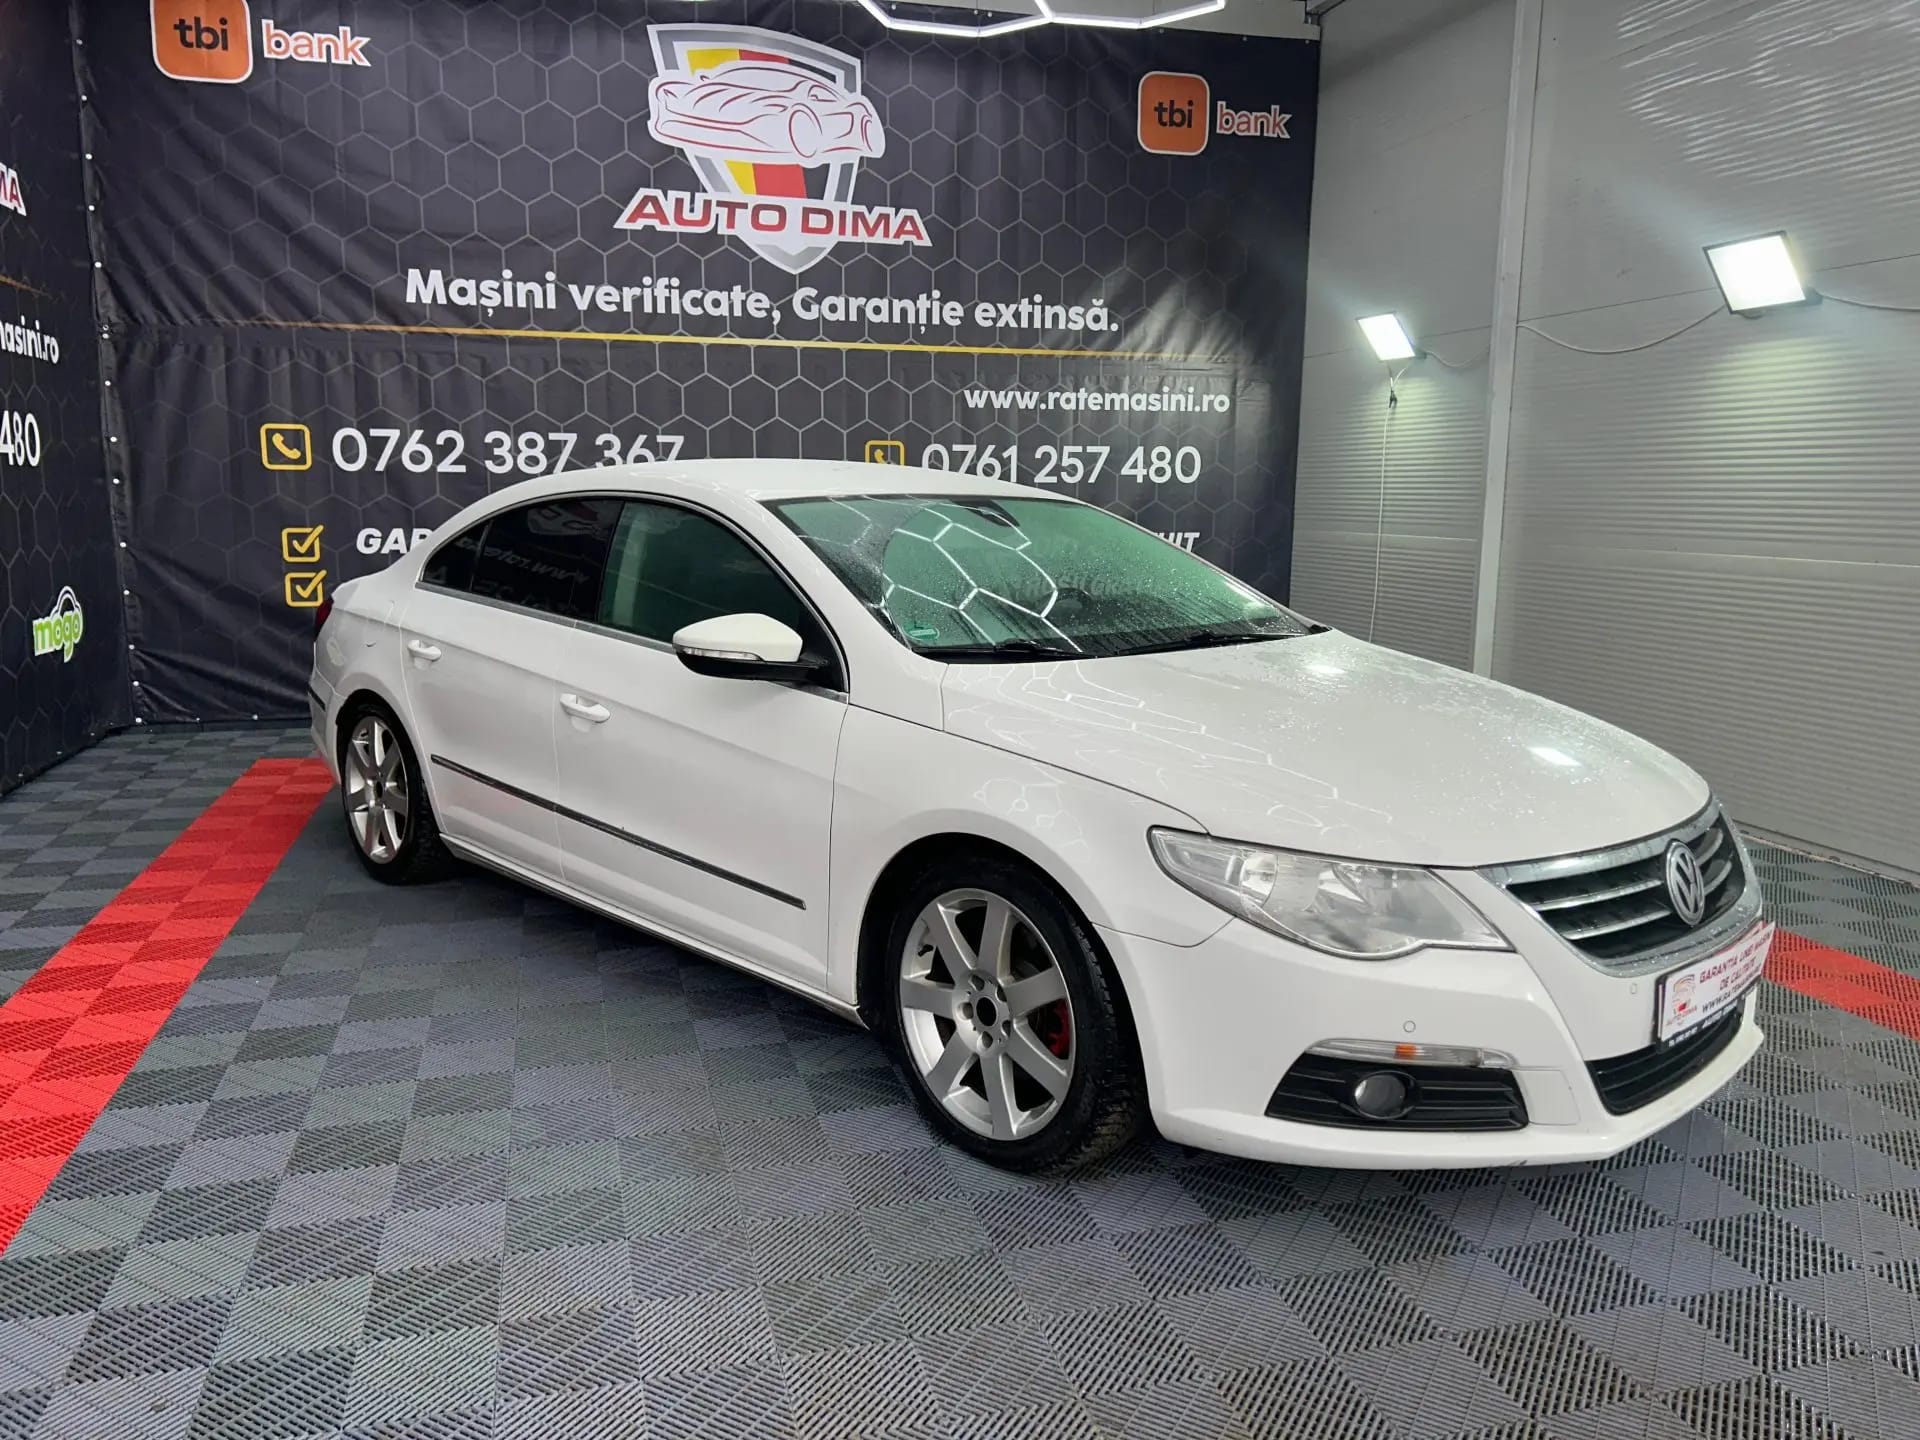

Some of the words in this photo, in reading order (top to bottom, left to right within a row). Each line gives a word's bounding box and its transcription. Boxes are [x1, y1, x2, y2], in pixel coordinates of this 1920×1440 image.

[173, 16, 229, 51] tbi
[262, 19, 371, 67] bank
[1154, 100, 1194, 128] tbi
[1216, 101, 1292, 138] bank
[625, 194, 787, 232] AUTO
[801, 206, 924, 240] DIMA
[567, 276, 782, 326] verificate,
[974, 293, 1119, 331] extinsă.
[963, 386, 1231, 413] www.ratemasini.ro
[0, 410, 41, 467] 480
[332, 427, 467, 474] 0762
[484, 430, 578, 475] 387
[594, 433, 685, 468] 367
[921, 443, 1019, 482] 0761
[1033, 445, 1111, 484] 257
[1120, 445, 1202, 484] 480
[33, 609, 83, 663] mogo
